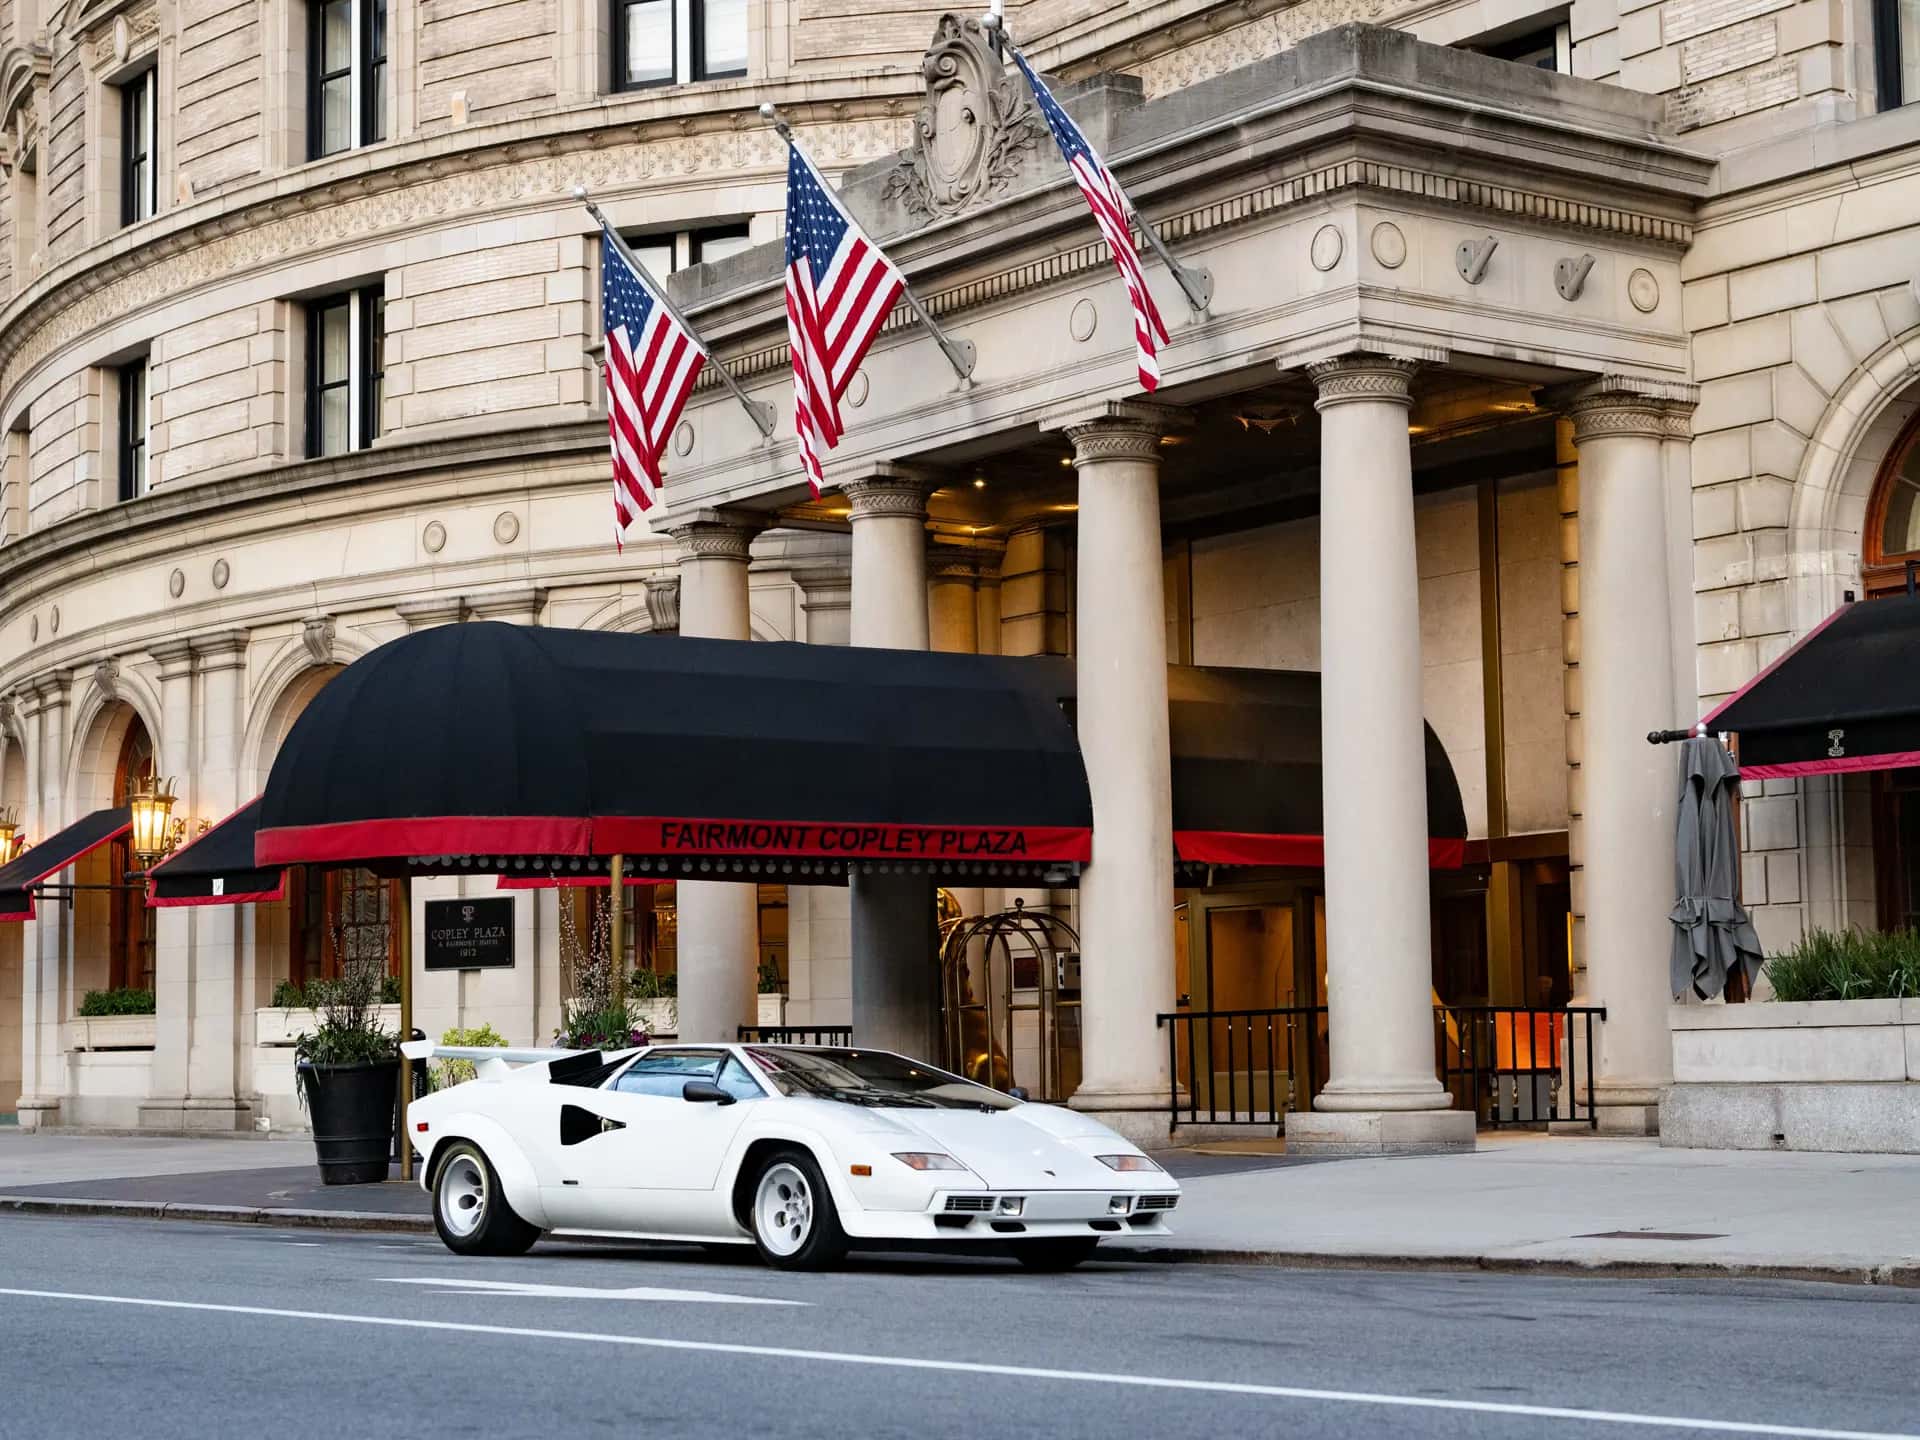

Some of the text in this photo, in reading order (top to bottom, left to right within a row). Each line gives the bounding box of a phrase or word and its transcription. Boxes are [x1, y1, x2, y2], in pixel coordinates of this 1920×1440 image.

[661, 822, 1027, 855] FAIRMONT COPLEY PLAZA
[431, 926, 506, 940] COPLEY PLAZA
